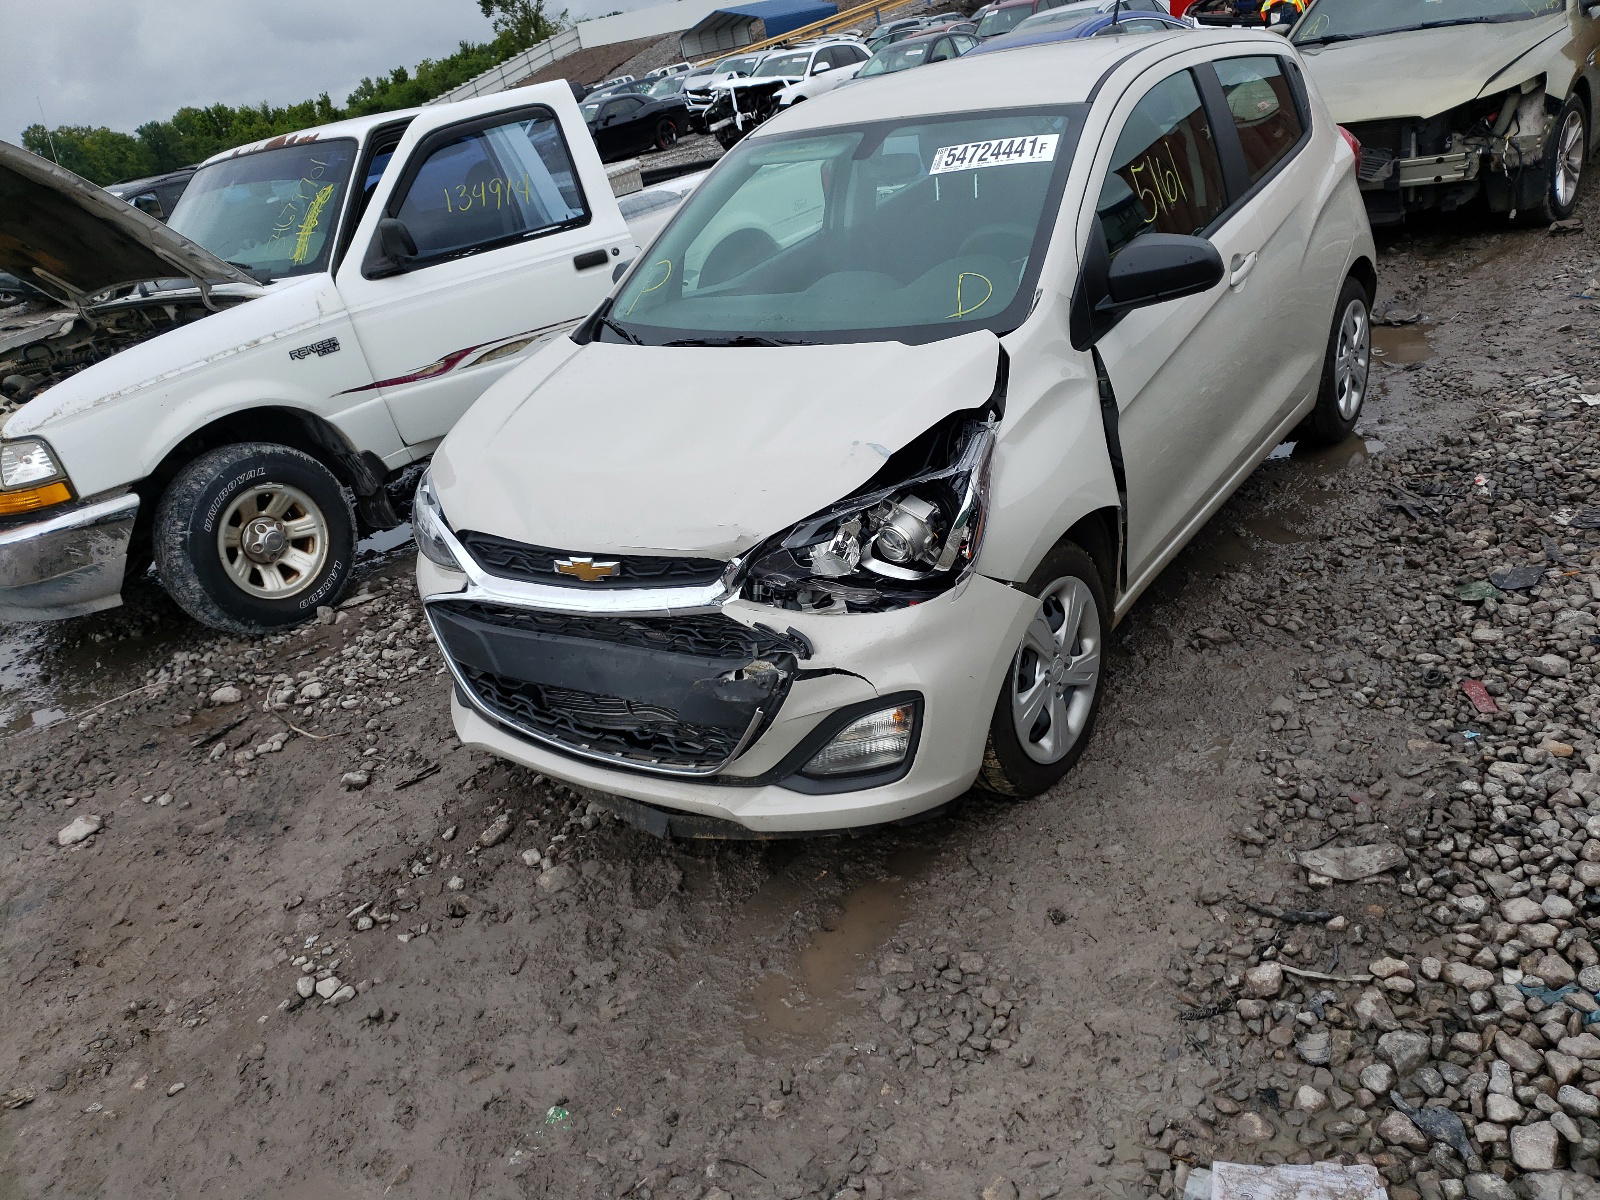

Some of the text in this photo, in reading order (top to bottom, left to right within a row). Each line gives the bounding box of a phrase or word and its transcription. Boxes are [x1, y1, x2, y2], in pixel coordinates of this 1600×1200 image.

[444, 173, 530, 213] 134914
[945, 272, 993, 319] D
[288, 336, 339, 361] RANGER
[203, 467, 266, 533] UNIROYAL
[299, 560, 342, 609] LAREDO
